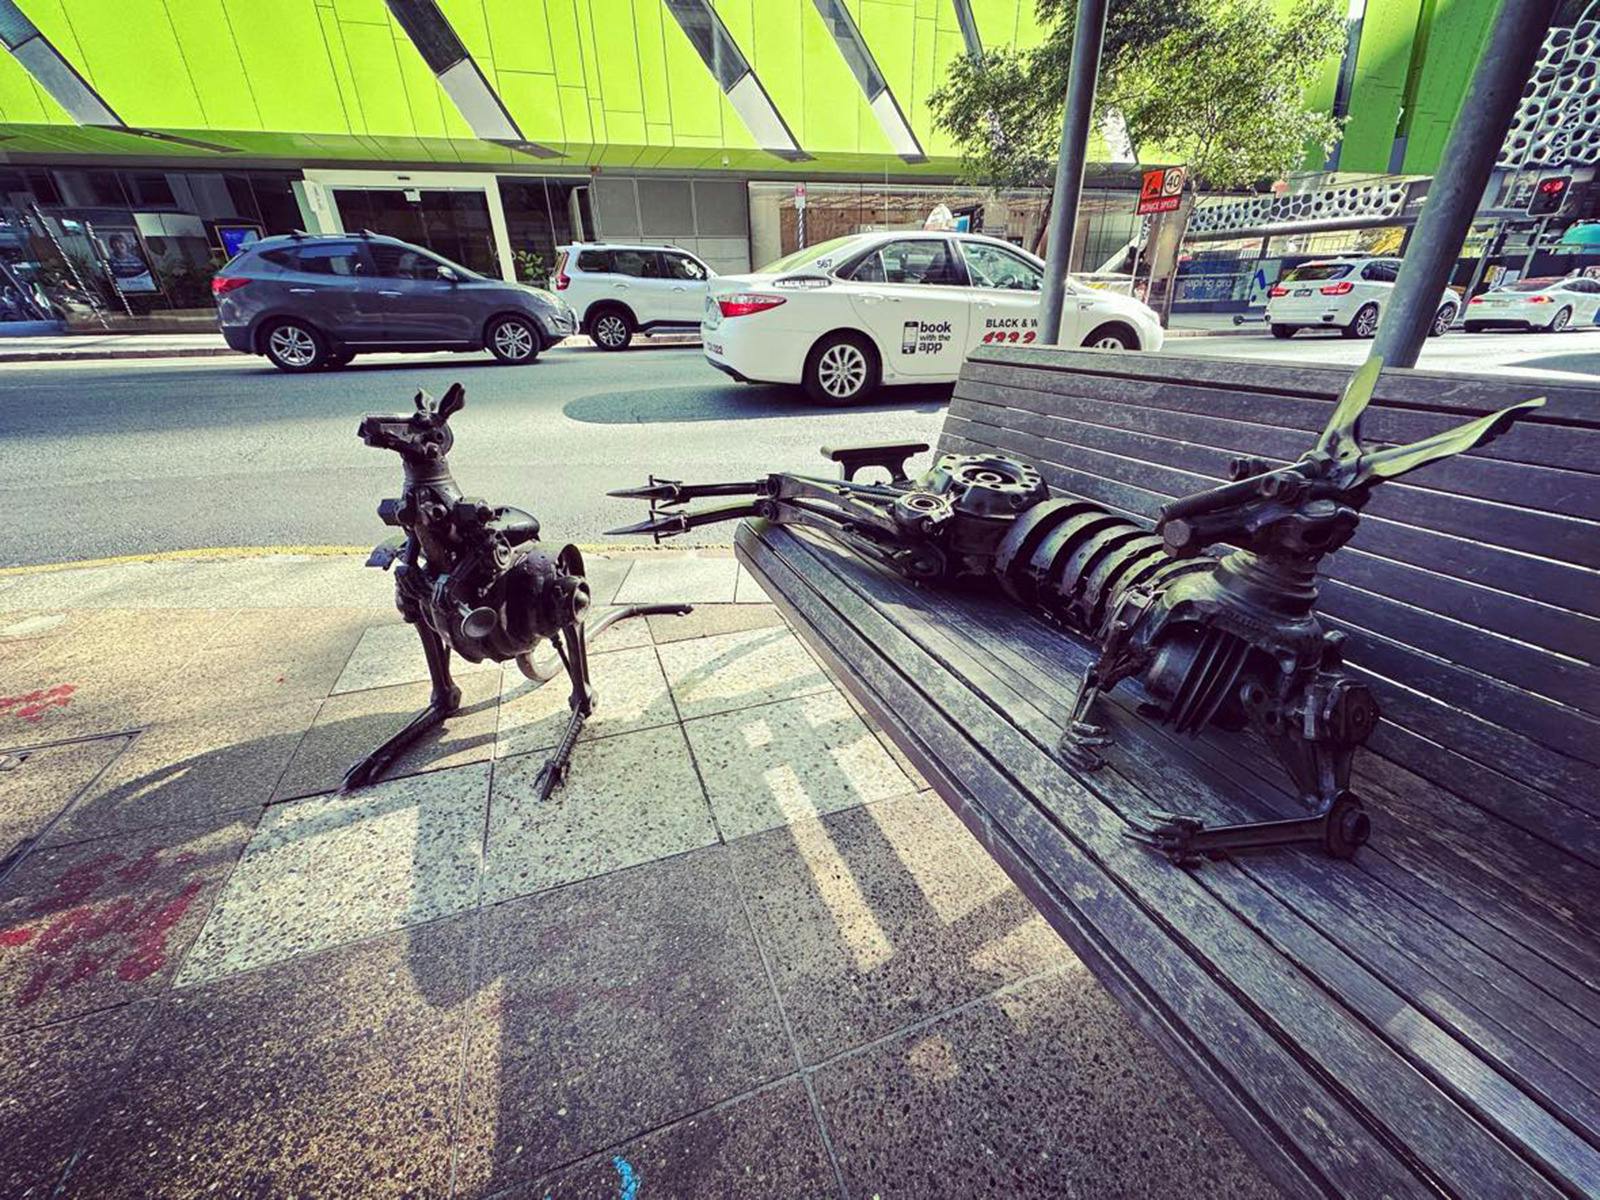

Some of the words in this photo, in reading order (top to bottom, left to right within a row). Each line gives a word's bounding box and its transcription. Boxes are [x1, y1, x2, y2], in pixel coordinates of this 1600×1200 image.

[1166, 174, 1181, 188] 40
[920, 321, 951, 333] book
[985, 318, 1018, 328] BLACK
[1021, 318, 1027, 328] &
[919, 342, 942, 354] app
